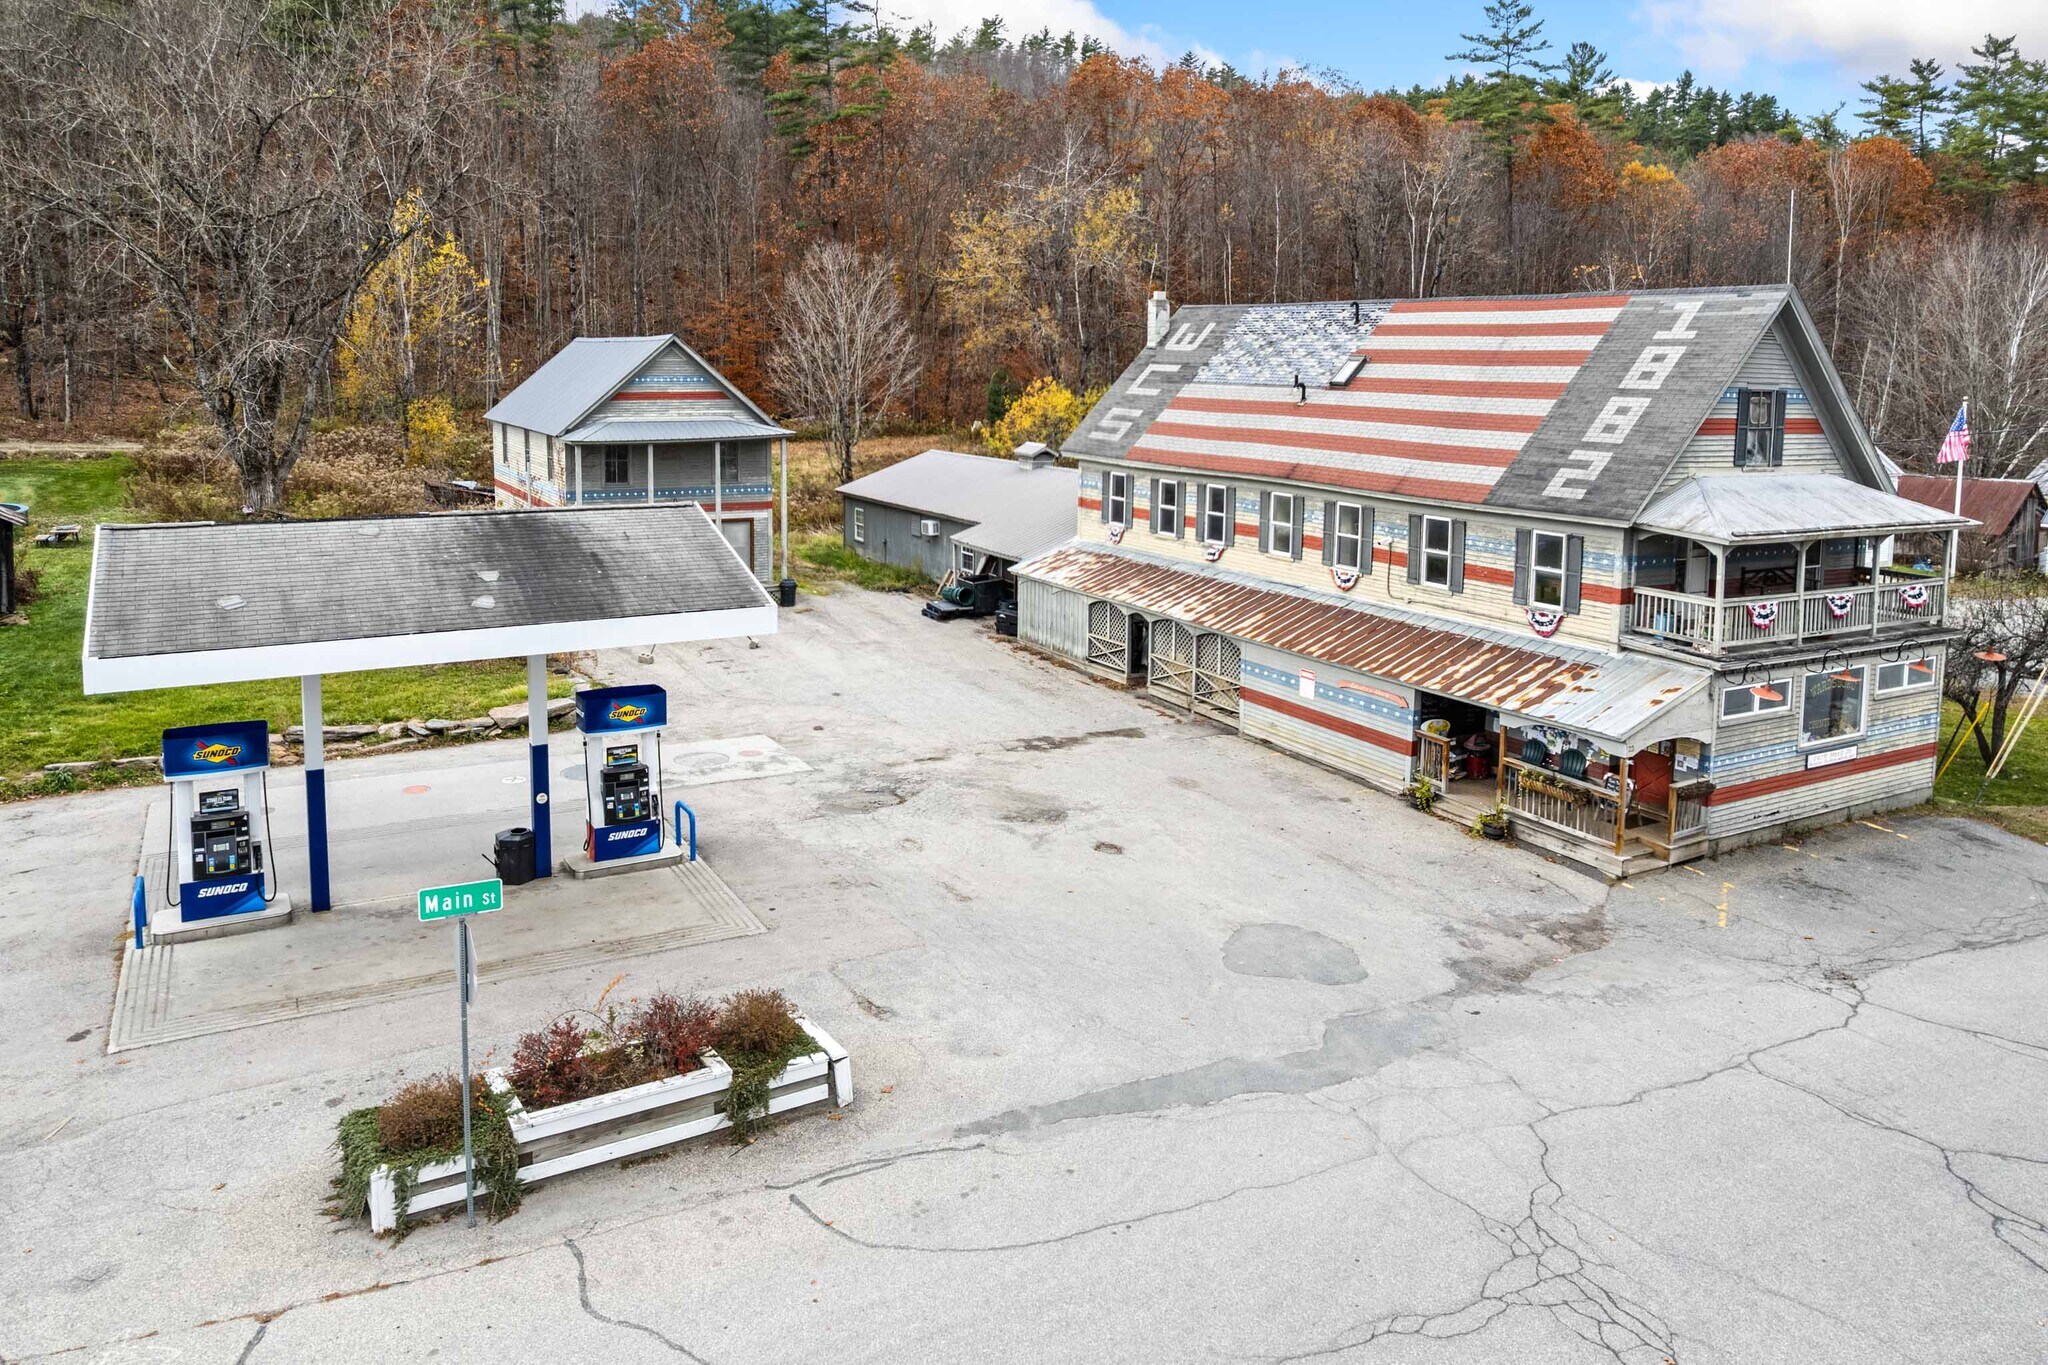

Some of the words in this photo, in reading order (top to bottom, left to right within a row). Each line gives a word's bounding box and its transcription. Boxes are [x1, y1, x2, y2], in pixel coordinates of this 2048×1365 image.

[1540, 300, 1704, 501] 1882
[610, 706, 647, 719] SUNOCO
[195, 746, 241, 760] SUNOCO
[607, 827, 648, 842] SUNOCO
[197, 882, 249, 899] SUNOCO
[425, 891, 473, 913] Main
[482, 892, 495, 905] St
